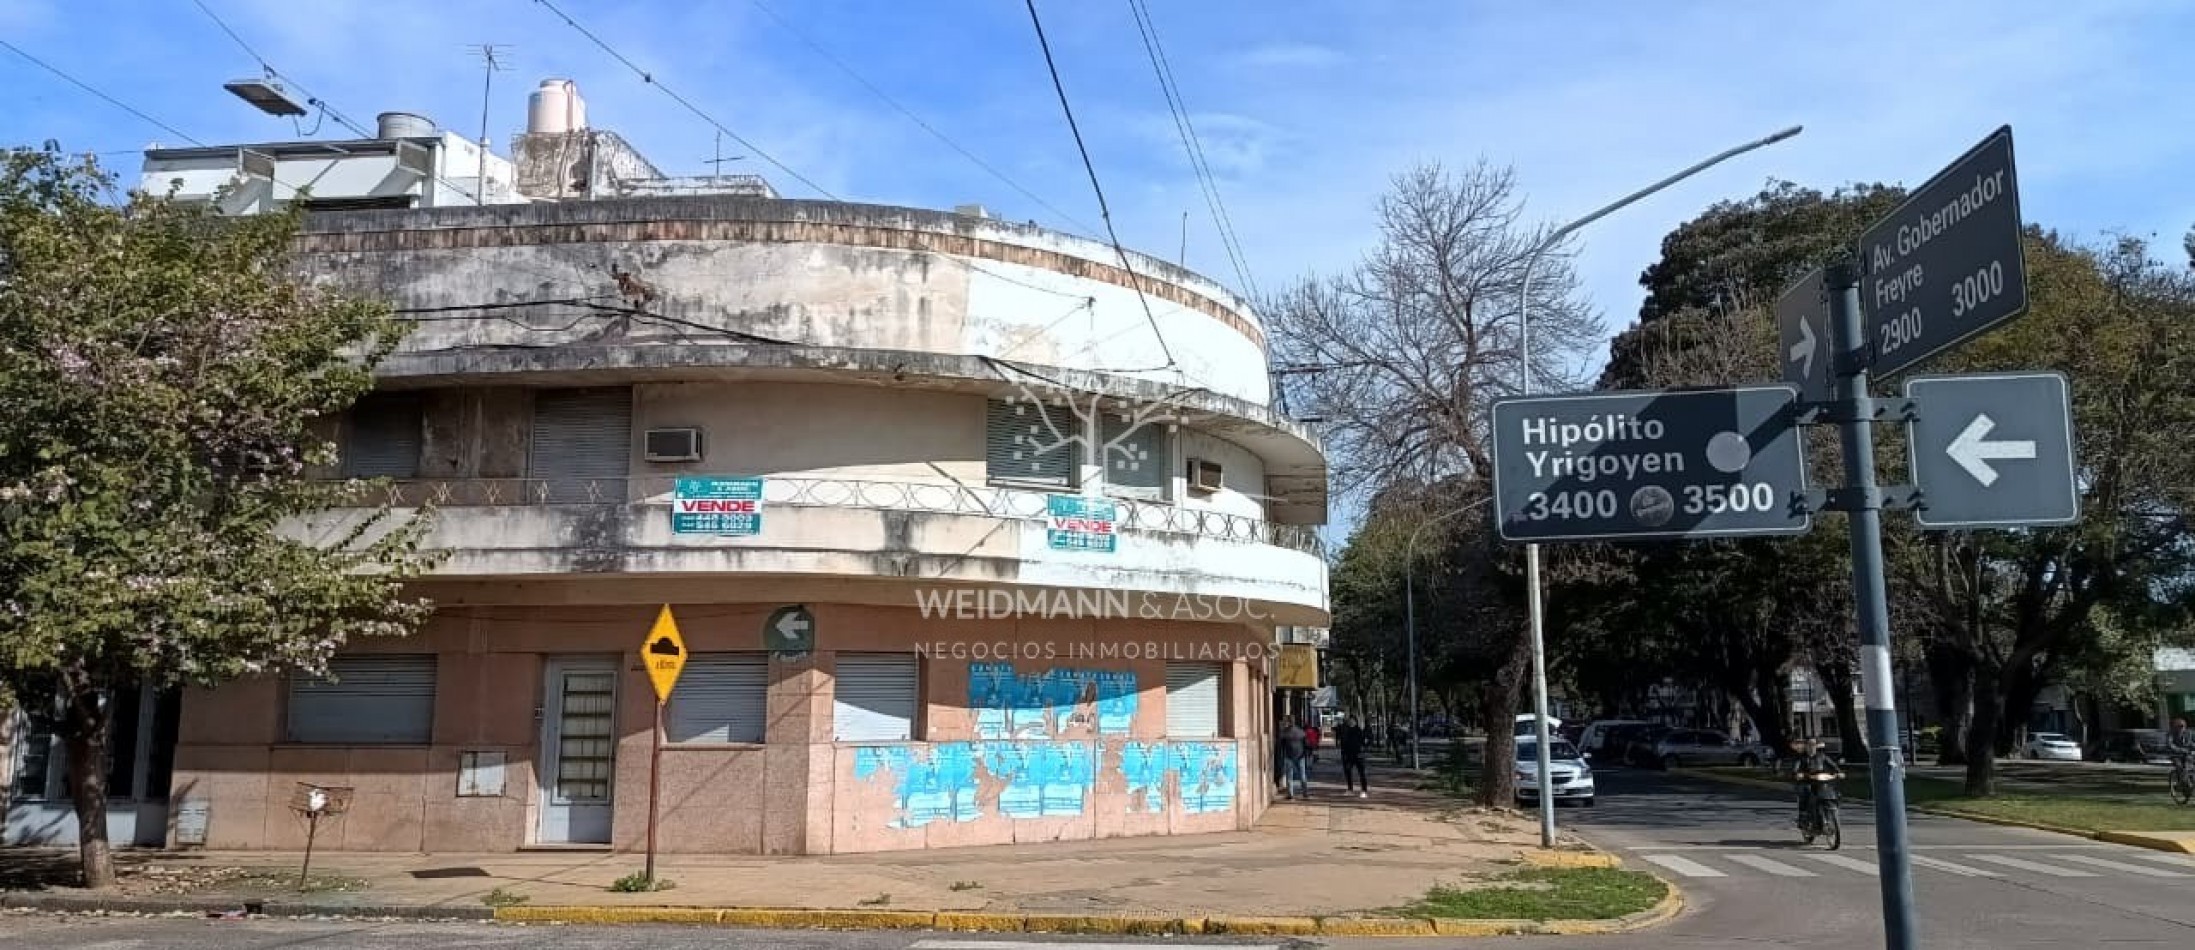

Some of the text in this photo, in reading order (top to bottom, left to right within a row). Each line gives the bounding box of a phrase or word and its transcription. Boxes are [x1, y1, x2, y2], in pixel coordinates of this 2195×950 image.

[1873, 168, 2005, 275] Av. Gobernador
[1875, 263, 1924, 309] Freyre
[1880, 260, 2004, 354] 2900 3000
[1522, 414, 1665, 447] Hipólito
[1525, 450, 1685, 481] Yrigoyen
[681, 500, 756, 512] VENDE
[1527, 482, 1775, 521] 3400 3500
[1054, 517, 1112, 533] VENDE
